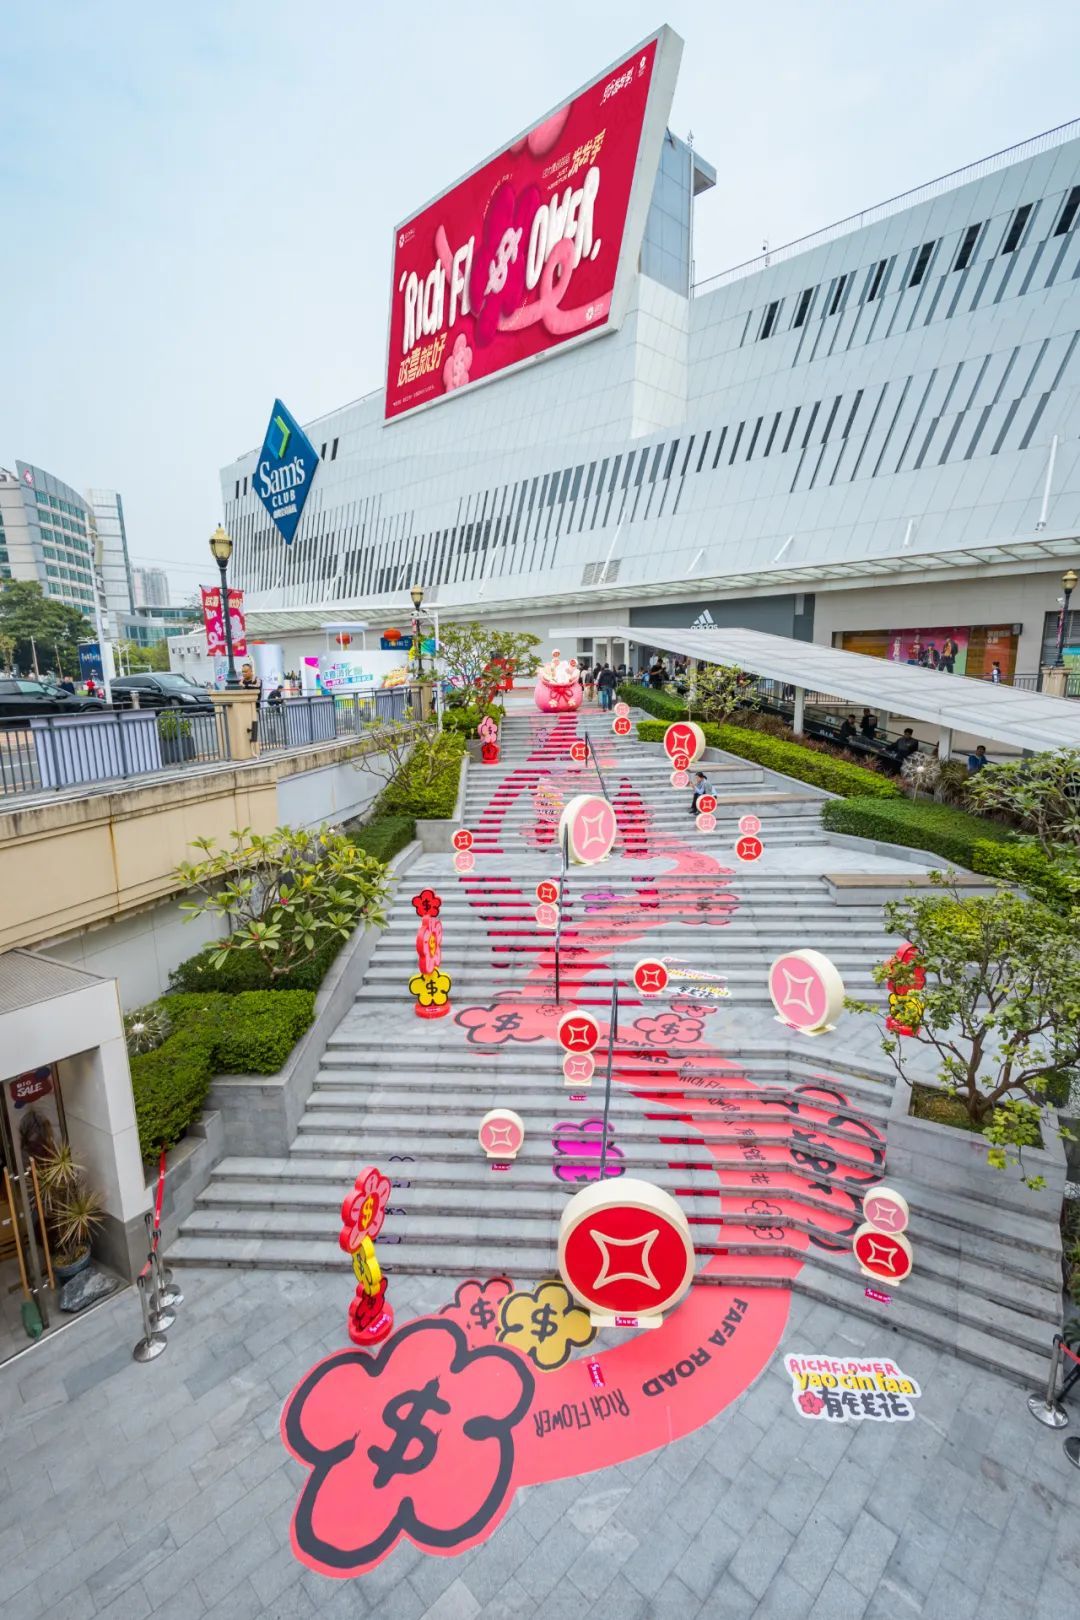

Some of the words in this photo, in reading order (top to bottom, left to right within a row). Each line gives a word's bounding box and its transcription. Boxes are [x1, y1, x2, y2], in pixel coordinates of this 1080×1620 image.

[259, 456, 306, 499] Sam's
[272, 489, 297, 508] CLUB
[690, 623, 720, 632] adidas
[17, 1082, 43, 1097] SALE
[708, 1297, 749, 1347] FAFA
[641, 1346, 713, 1398] ROAD
[794, 1371, 838, 1391] yao
[876, 1370, 917, 1395] faa
[533, 1397, 592, 1438] FLOWER
[590, 1388, 631, 1421] RICH
